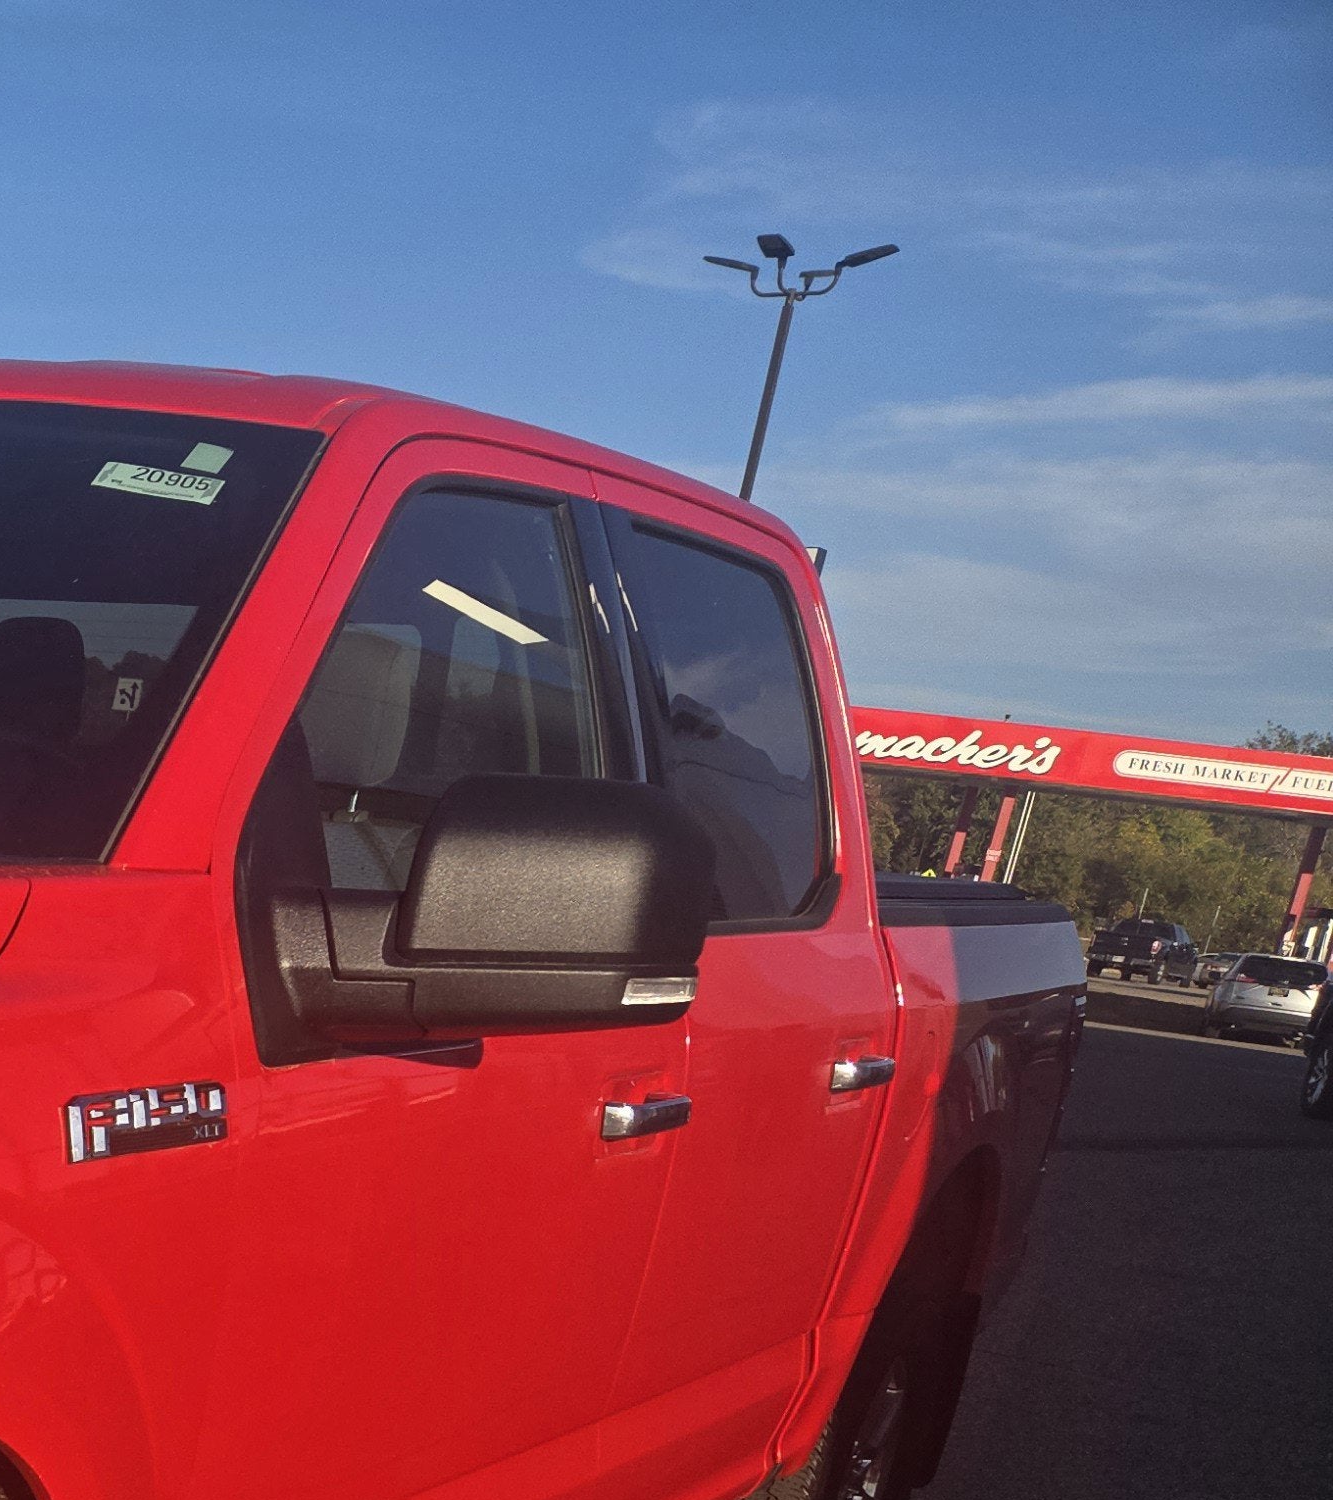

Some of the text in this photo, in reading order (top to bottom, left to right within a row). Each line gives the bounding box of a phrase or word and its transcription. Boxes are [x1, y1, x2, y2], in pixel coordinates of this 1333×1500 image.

[1128, 757, 1186, 775] FRESH
[1192, 764, 1271, 784] MARKET
[193, 1123, 222, 1140] XLT
